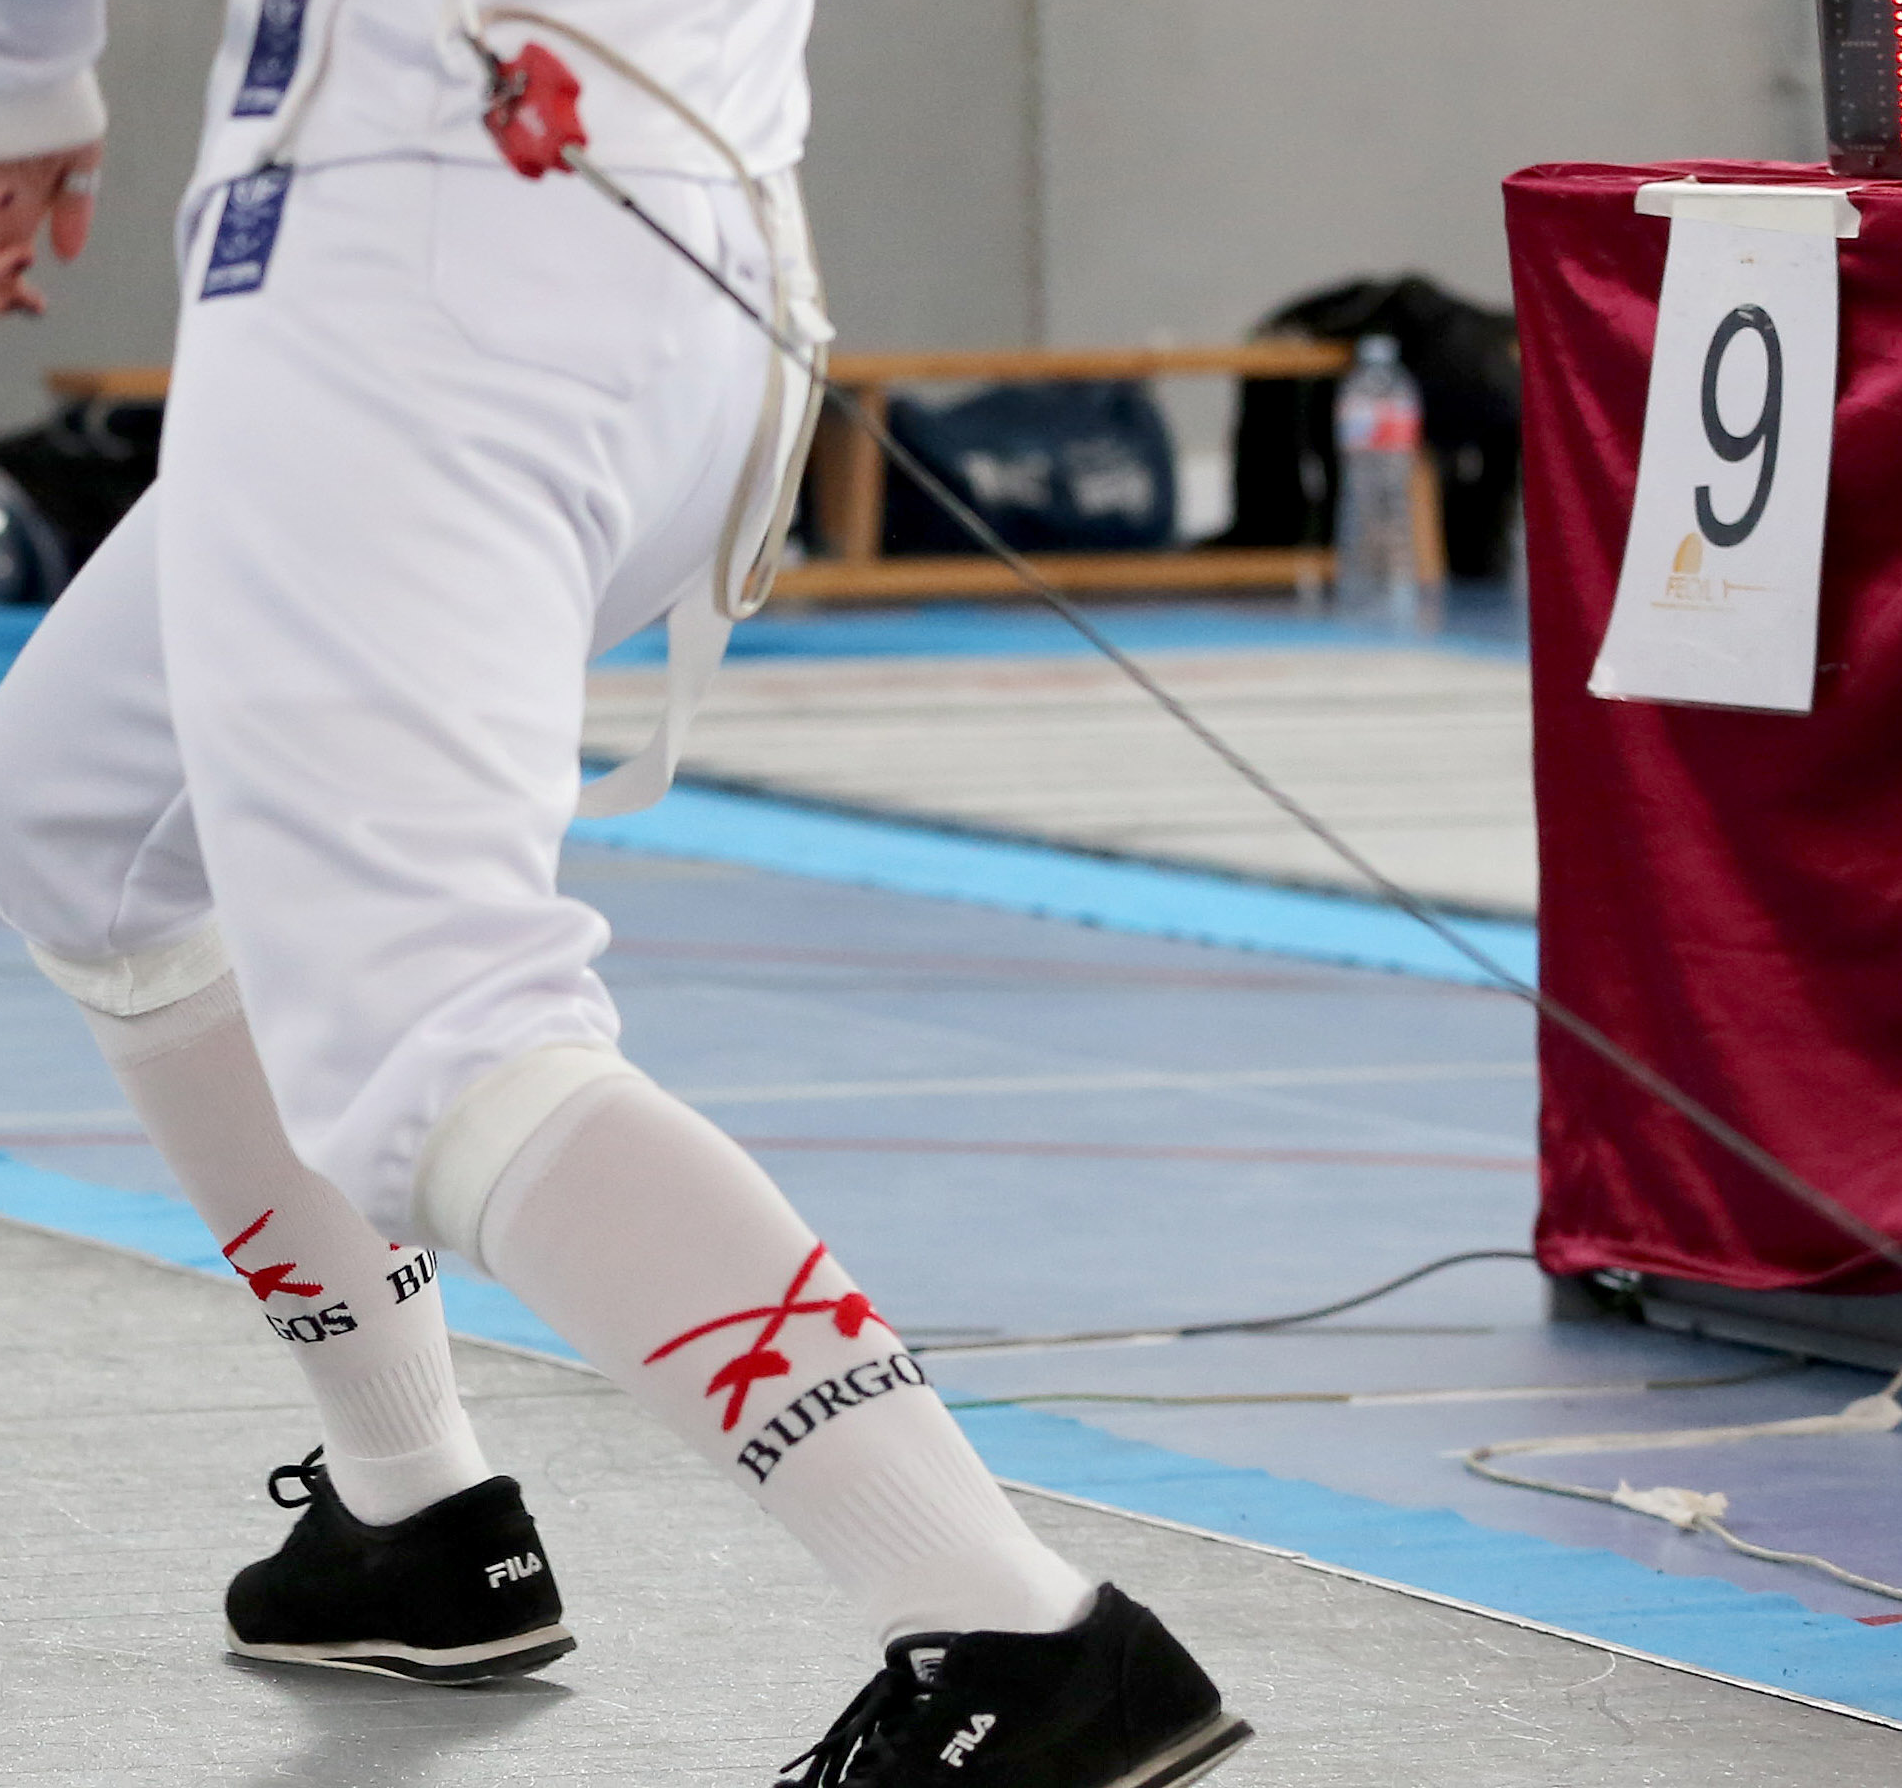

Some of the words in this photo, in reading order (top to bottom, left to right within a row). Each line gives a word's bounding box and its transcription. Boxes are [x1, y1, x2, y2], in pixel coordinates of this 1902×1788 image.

[1695, 303, 1783, 548] 9
[736, 1352, 928, 1484] BURGO
[484, 1552, 543, 1588] FILA
[939, 1713, 997, 1768] FILA
